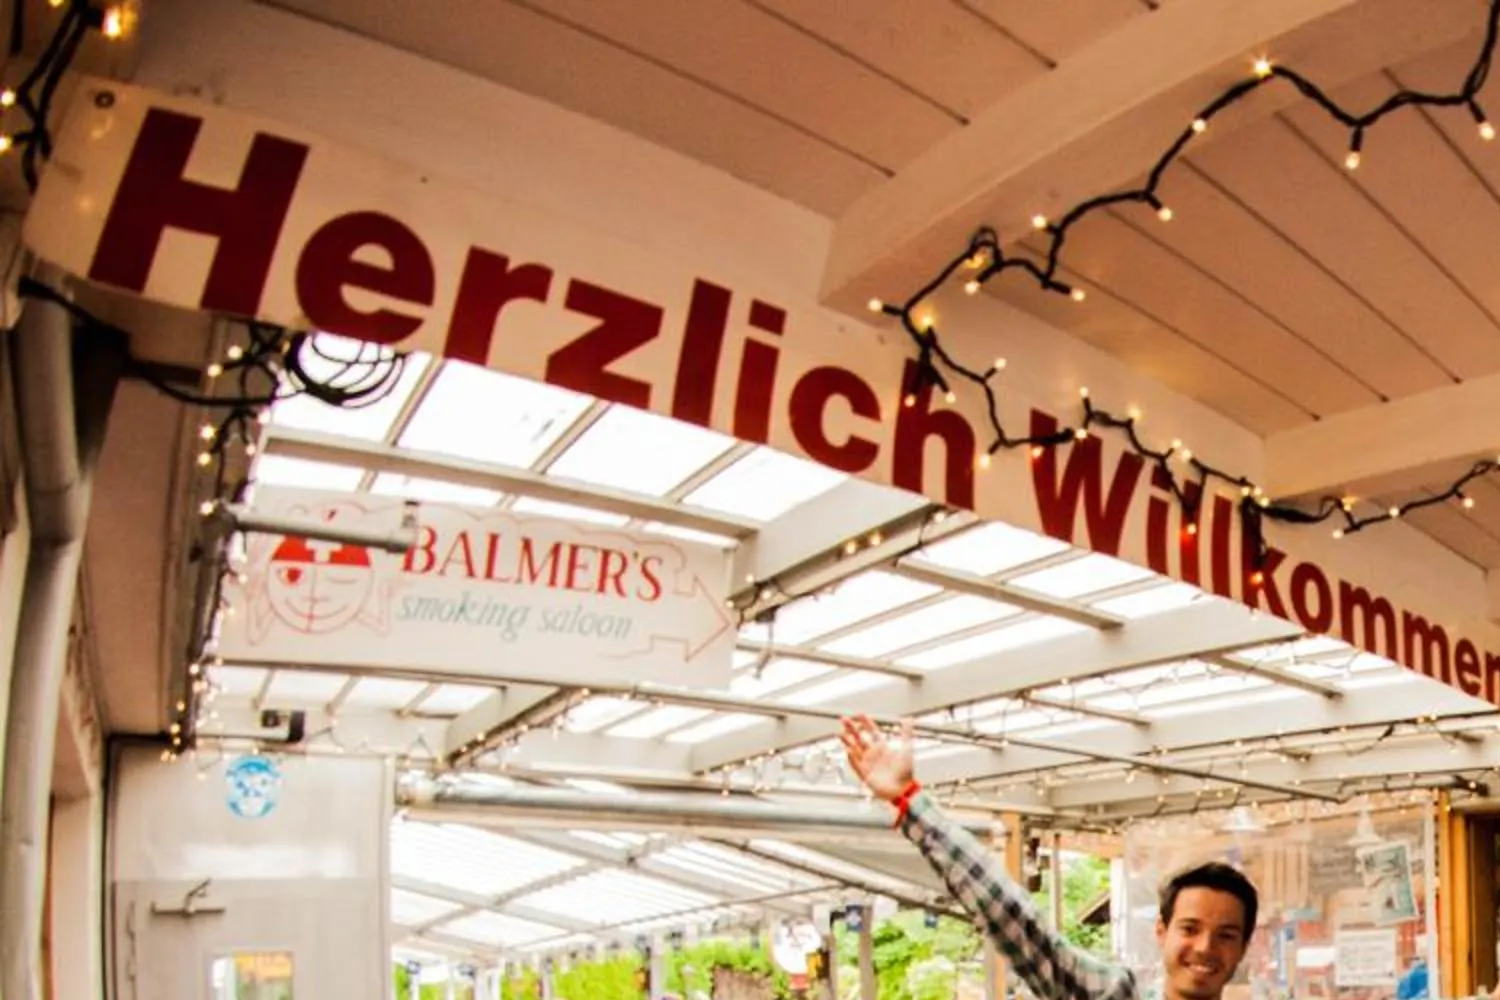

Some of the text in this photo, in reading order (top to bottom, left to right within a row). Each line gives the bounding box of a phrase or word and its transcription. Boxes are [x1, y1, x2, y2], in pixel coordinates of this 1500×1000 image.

[88, 106, 976, 513] Herzlich
[403, 525, 664, 602] BALMER'S
[400, 592, 634, 642] smoking saloon
